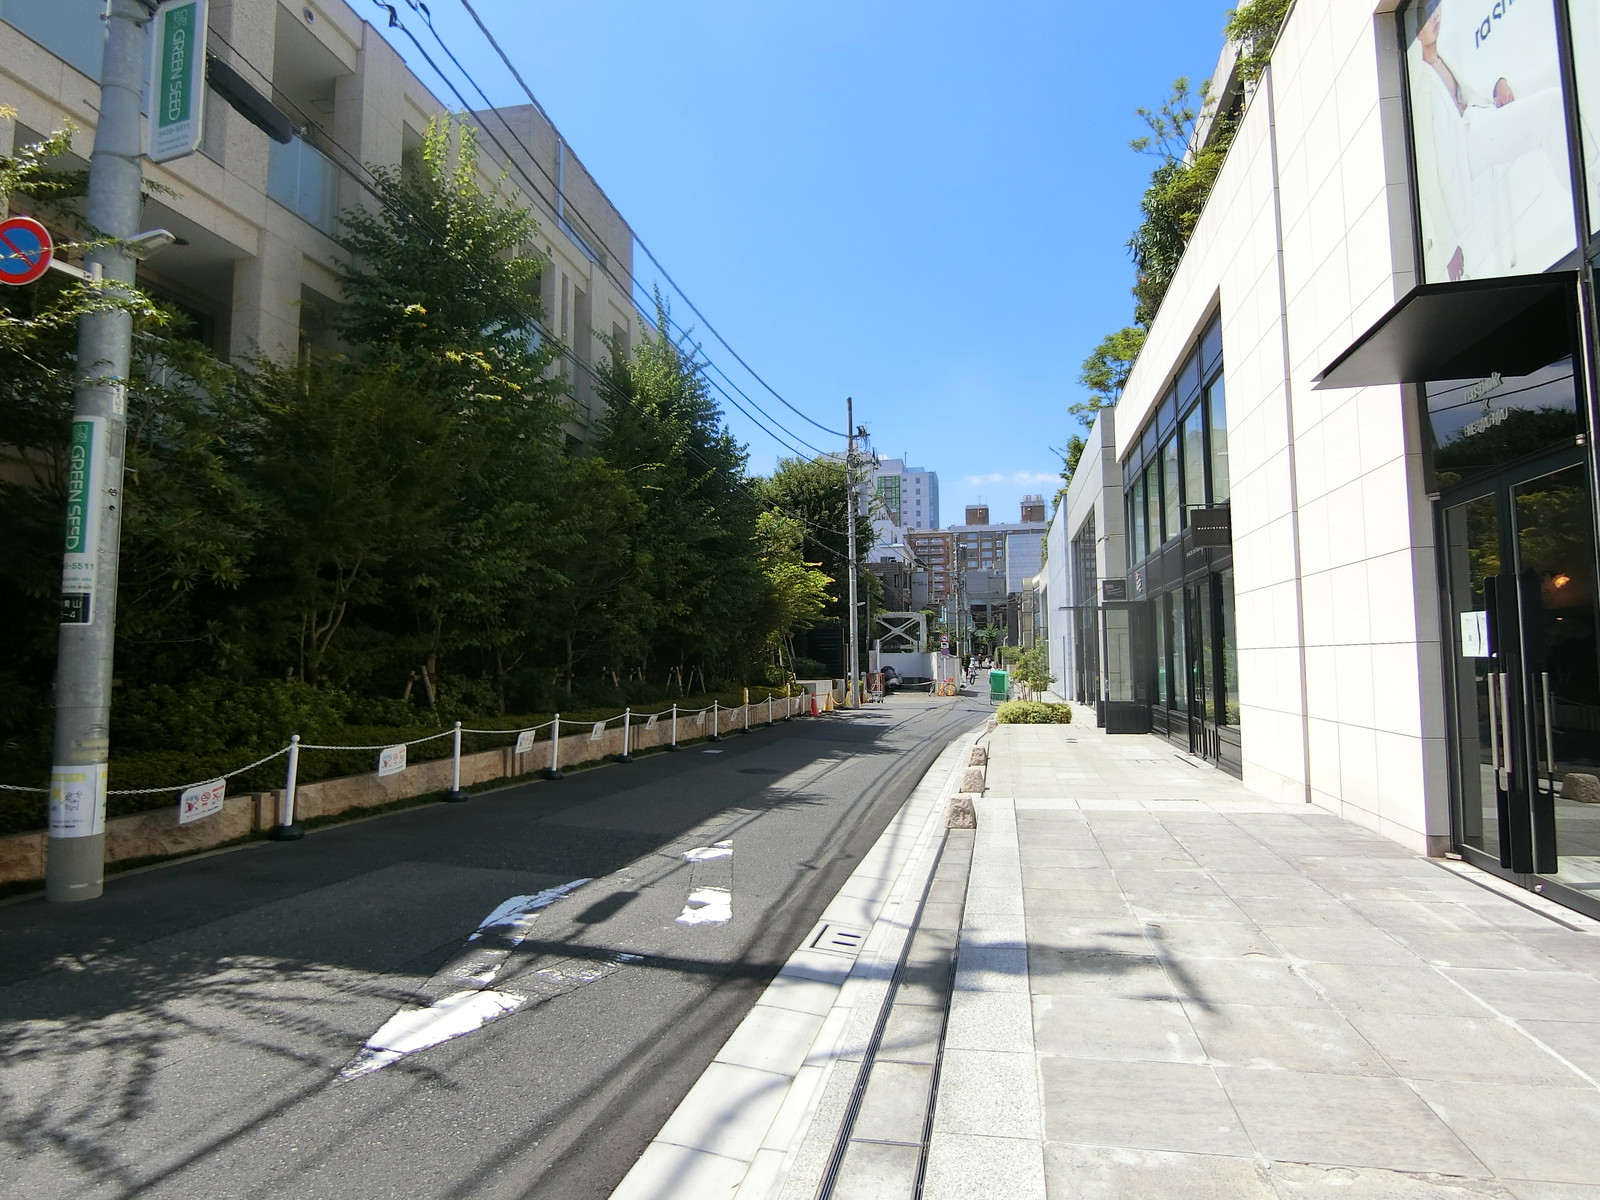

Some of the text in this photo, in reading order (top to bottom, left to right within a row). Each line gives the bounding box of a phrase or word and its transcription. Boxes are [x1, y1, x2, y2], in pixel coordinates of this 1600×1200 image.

[171, 29, 185, 80] GREEN
[168, 81, 182, 121] SEED
[66, 445, 86, 550] GREEN SEED
